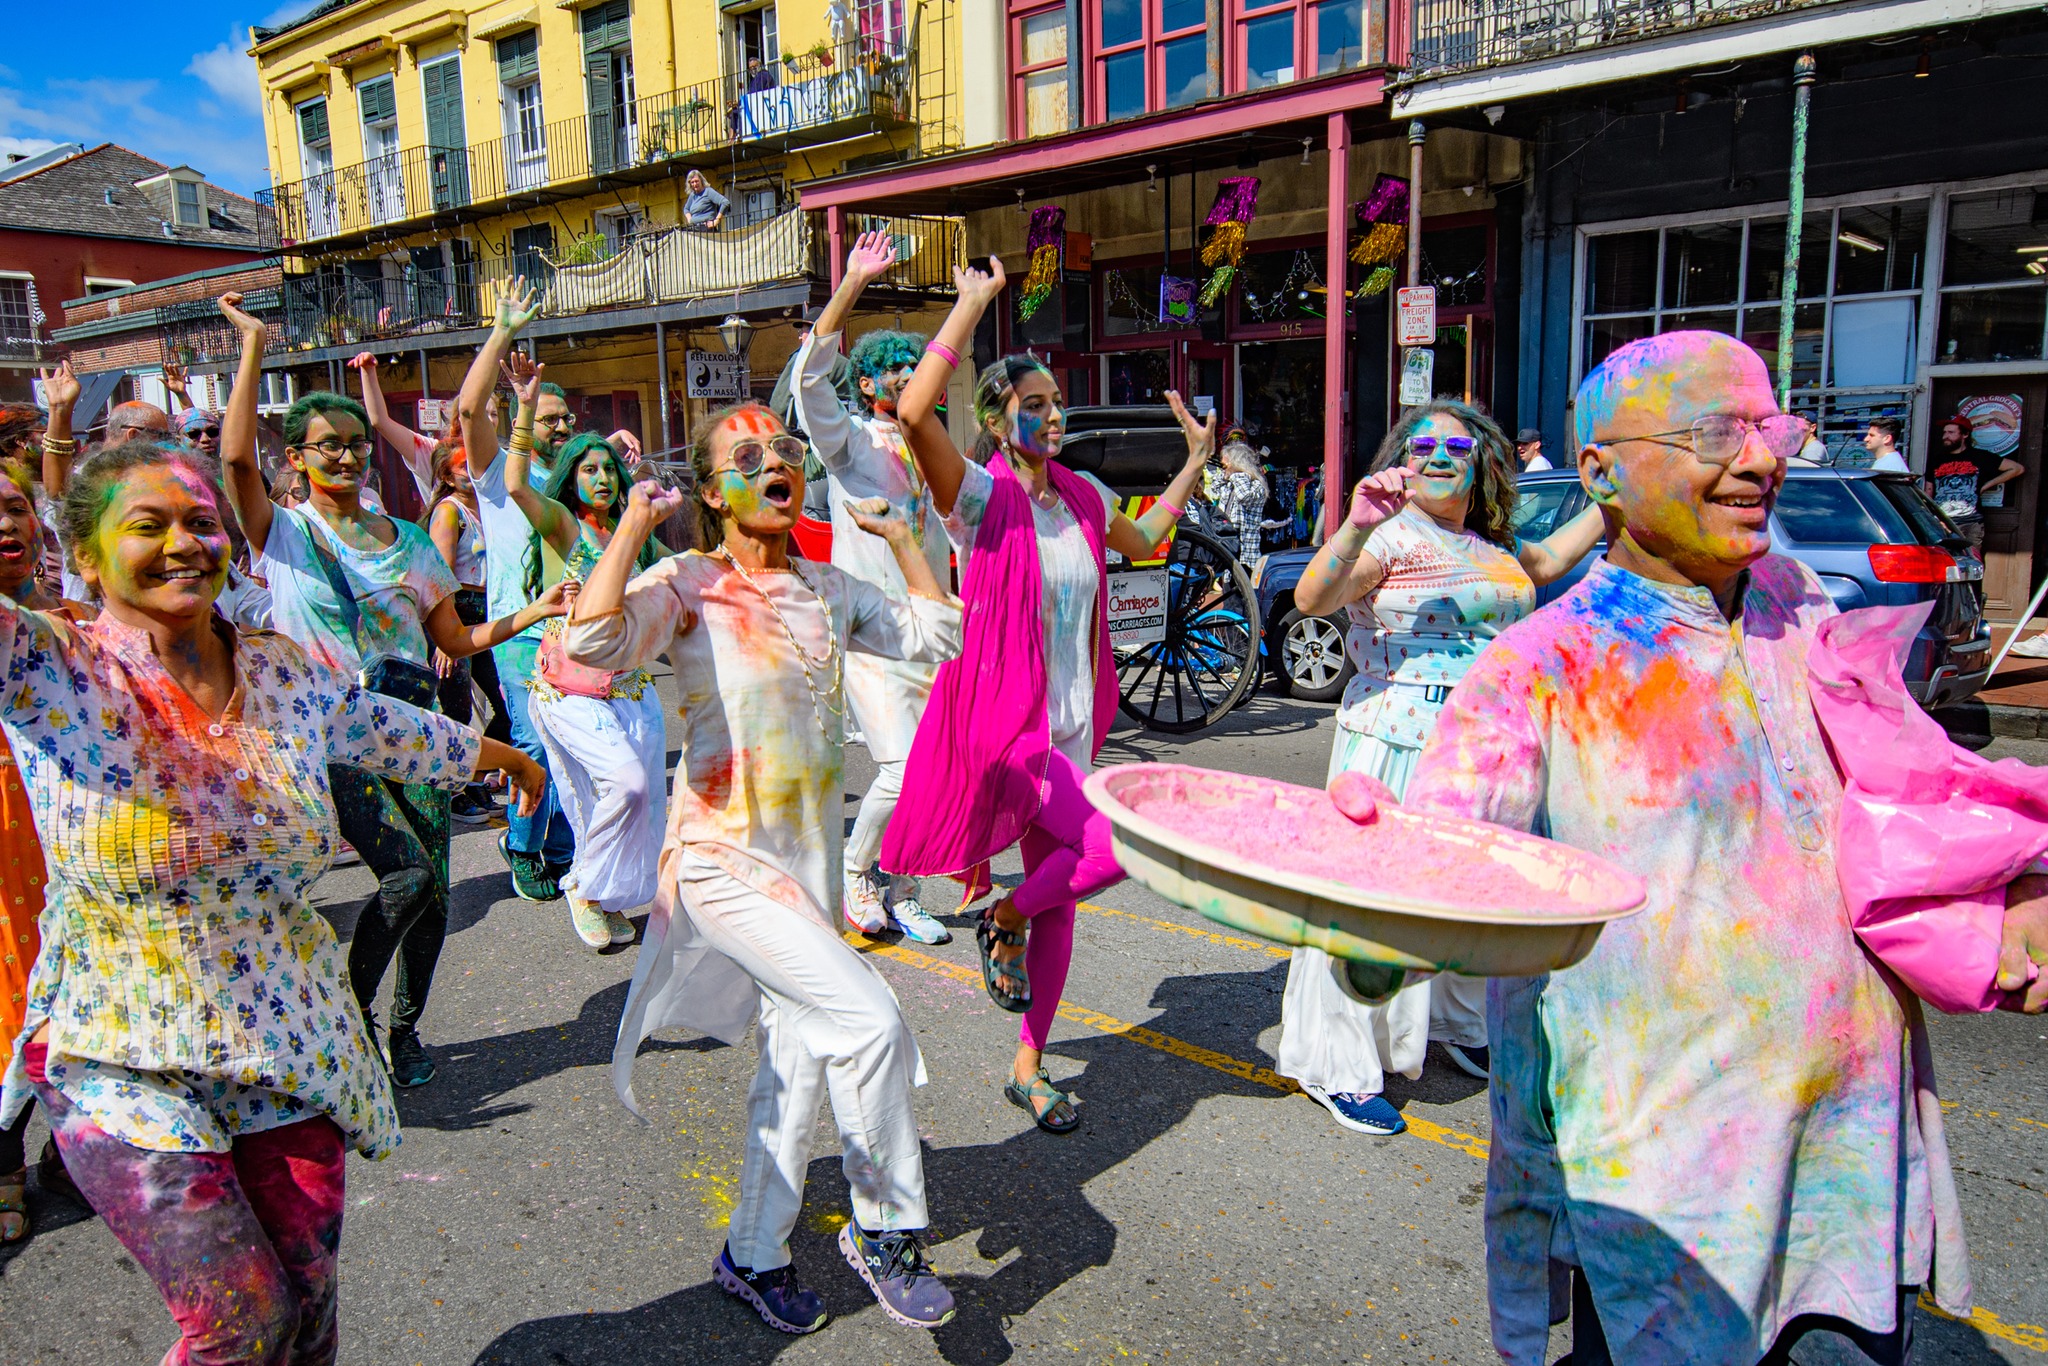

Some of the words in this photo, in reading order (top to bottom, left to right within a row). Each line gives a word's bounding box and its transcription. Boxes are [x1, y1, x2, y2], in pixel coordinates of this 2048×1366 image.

[1410, 292, 1433, 302] PARKING
[1402, 306, 1431, 316] FREIGHT
[1407, 316, 1427, 325] ZONE
[1280, 322, 1302, 336] 915
[692, 388, 712, 396] FOOT
[1960, 397, 1988, 417] ENTRAL
[1109, 594, 1160, 615] Carriages
